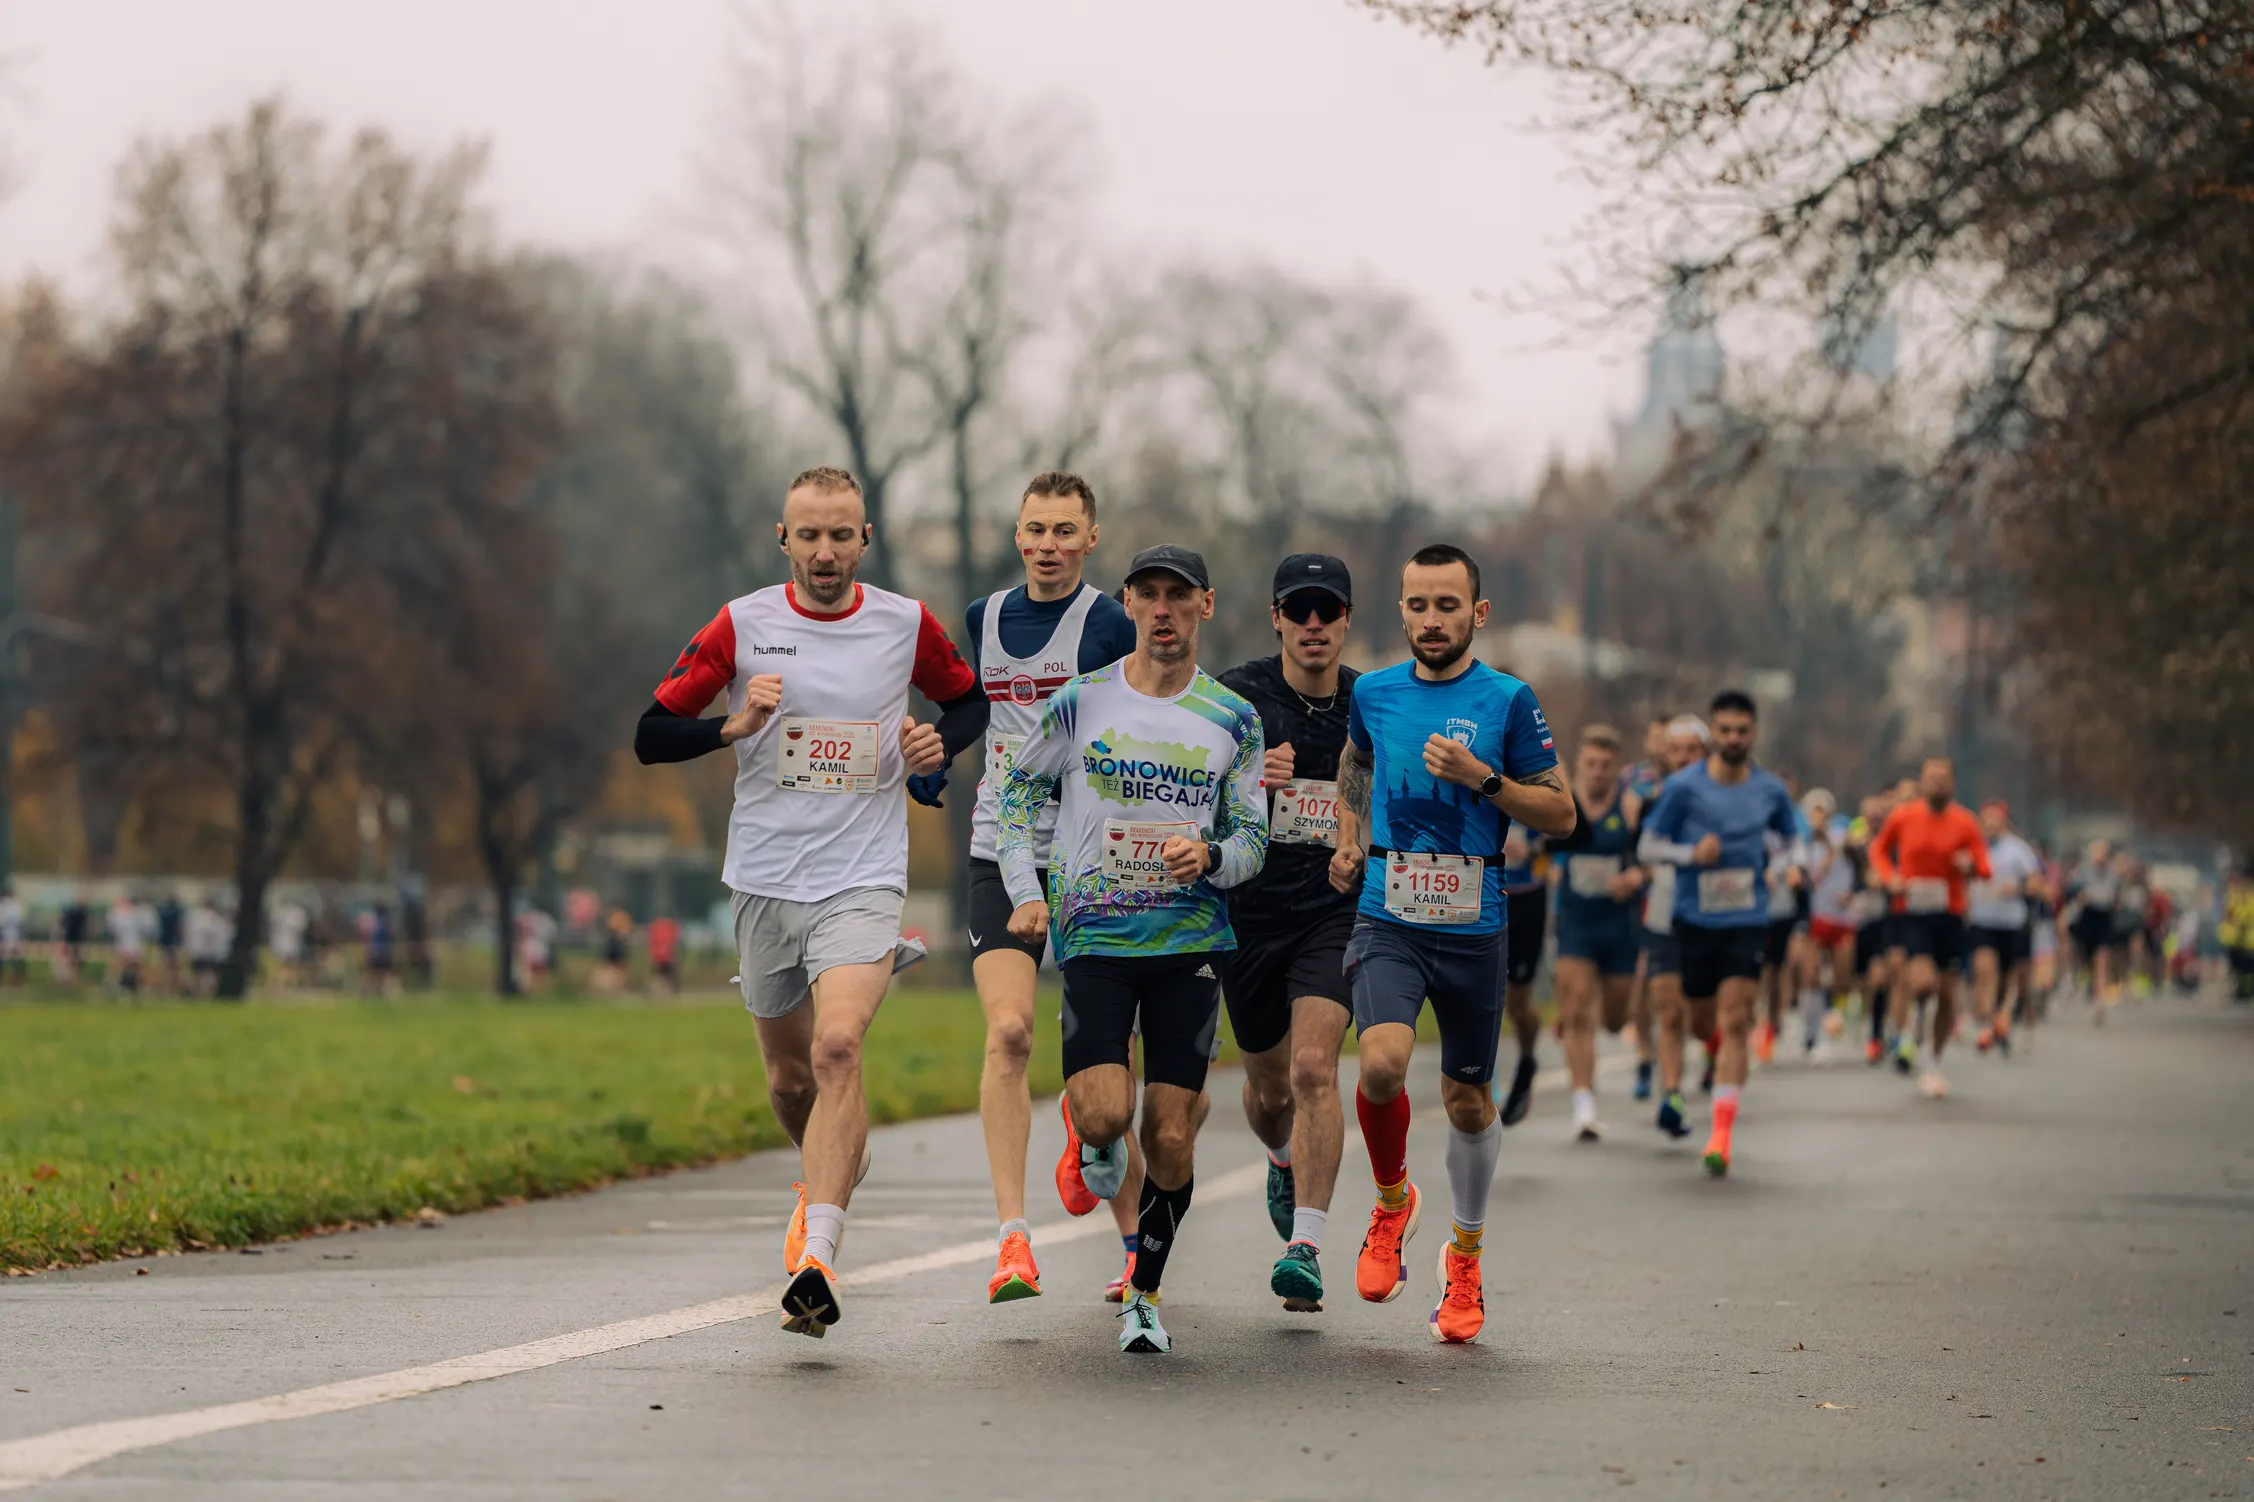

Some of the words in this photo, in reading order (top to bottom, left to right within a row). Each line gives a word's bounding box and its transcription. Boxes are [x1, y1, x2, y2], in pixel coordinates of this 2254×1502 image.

[753, 644, 797, 656] hummel
[1044, 661, 1067, 674] POL
[808, 739, 852, 760] 202
[809, 761, 849, 773] KAMIL
[1082, 755, 1216, 788] BRONOWICE
[1101, 778, 1120, 791] TEŻ
[1122, 780, 1214, 811] BIEGAJĄ
[1115, 859, 1168, 872] RADOSŁ
[1408, 872, 1460, 893] 1159
[1413, 893, 1451, 905] KAMIL
